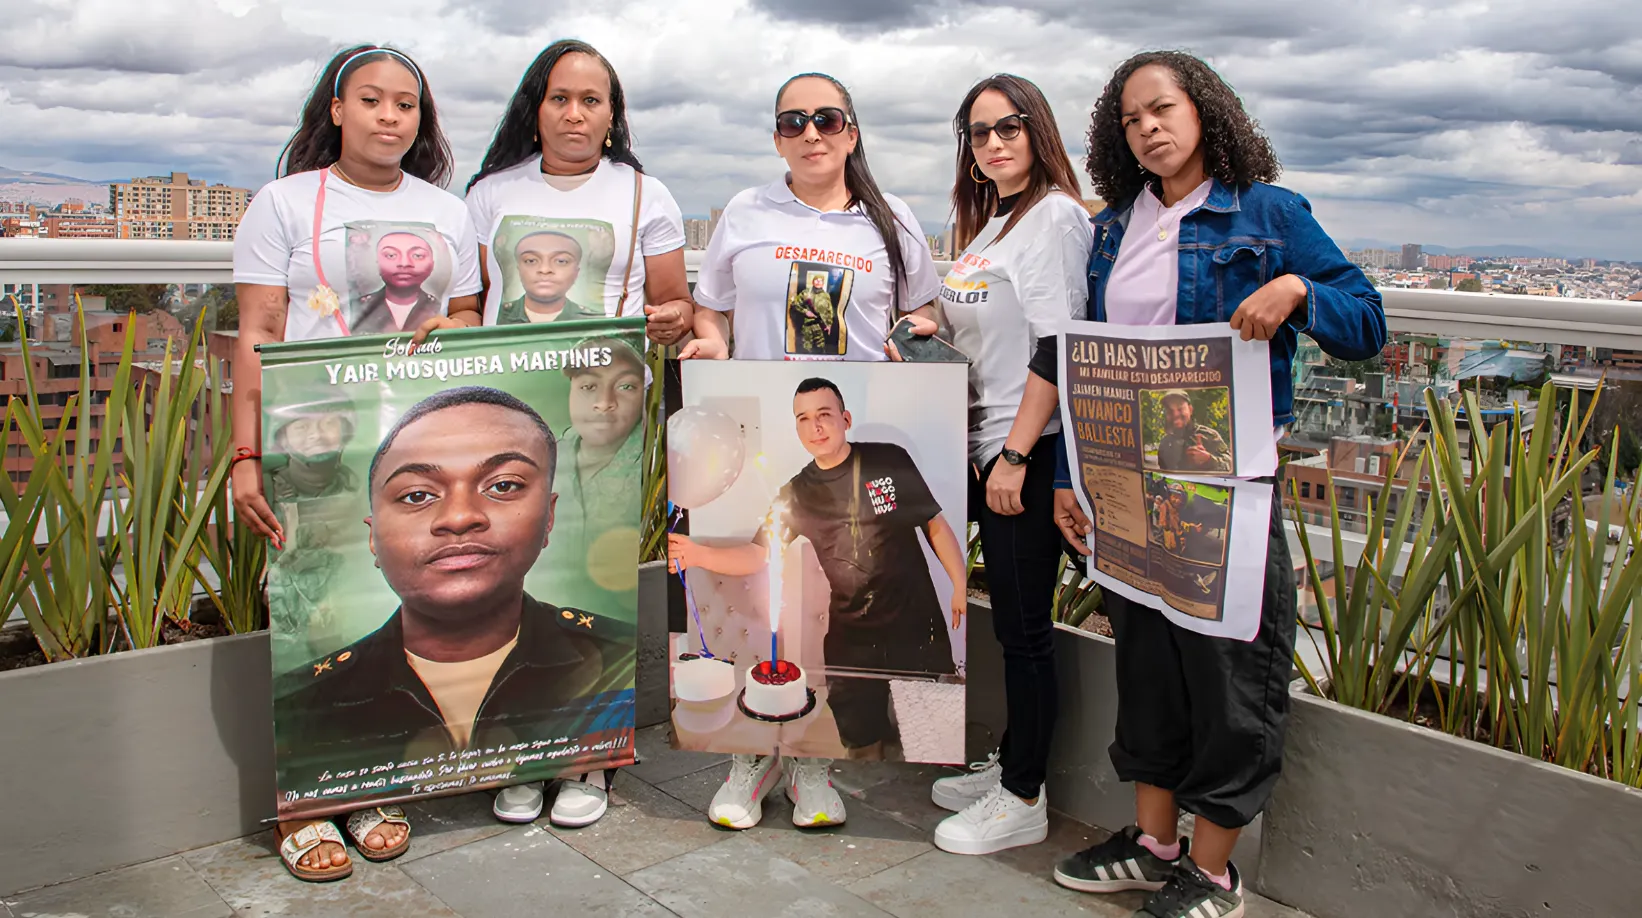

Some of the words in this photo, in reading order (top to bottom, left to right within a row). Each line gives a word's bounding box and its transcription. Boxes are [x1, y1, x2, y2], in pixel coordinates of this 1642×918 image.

[775, 246, 873, 273] DESAPARECIDO
[325, 362, 379, 385] YAIR
[386, 355, 504, 382] MOSQUERA
[510, 347, 612, 372] MARTINES
[1071, 340, 1099, 364] ¿LO
[1104, 342, 1138, 368] HAS
[1141, 344, 1209, 370] VISTO?
[1080, 366, 1090, 377] MI
[1092, 367, 1129, 382] FAMILIAR
[1150, 370, 1222, 385] DESAPARECIDO
[1103, 386, 1135, 401] MANUEL
[1072, 398, 1133, 424] VIVANCO
[1077, 421, 1136, 448] BALLESTA
